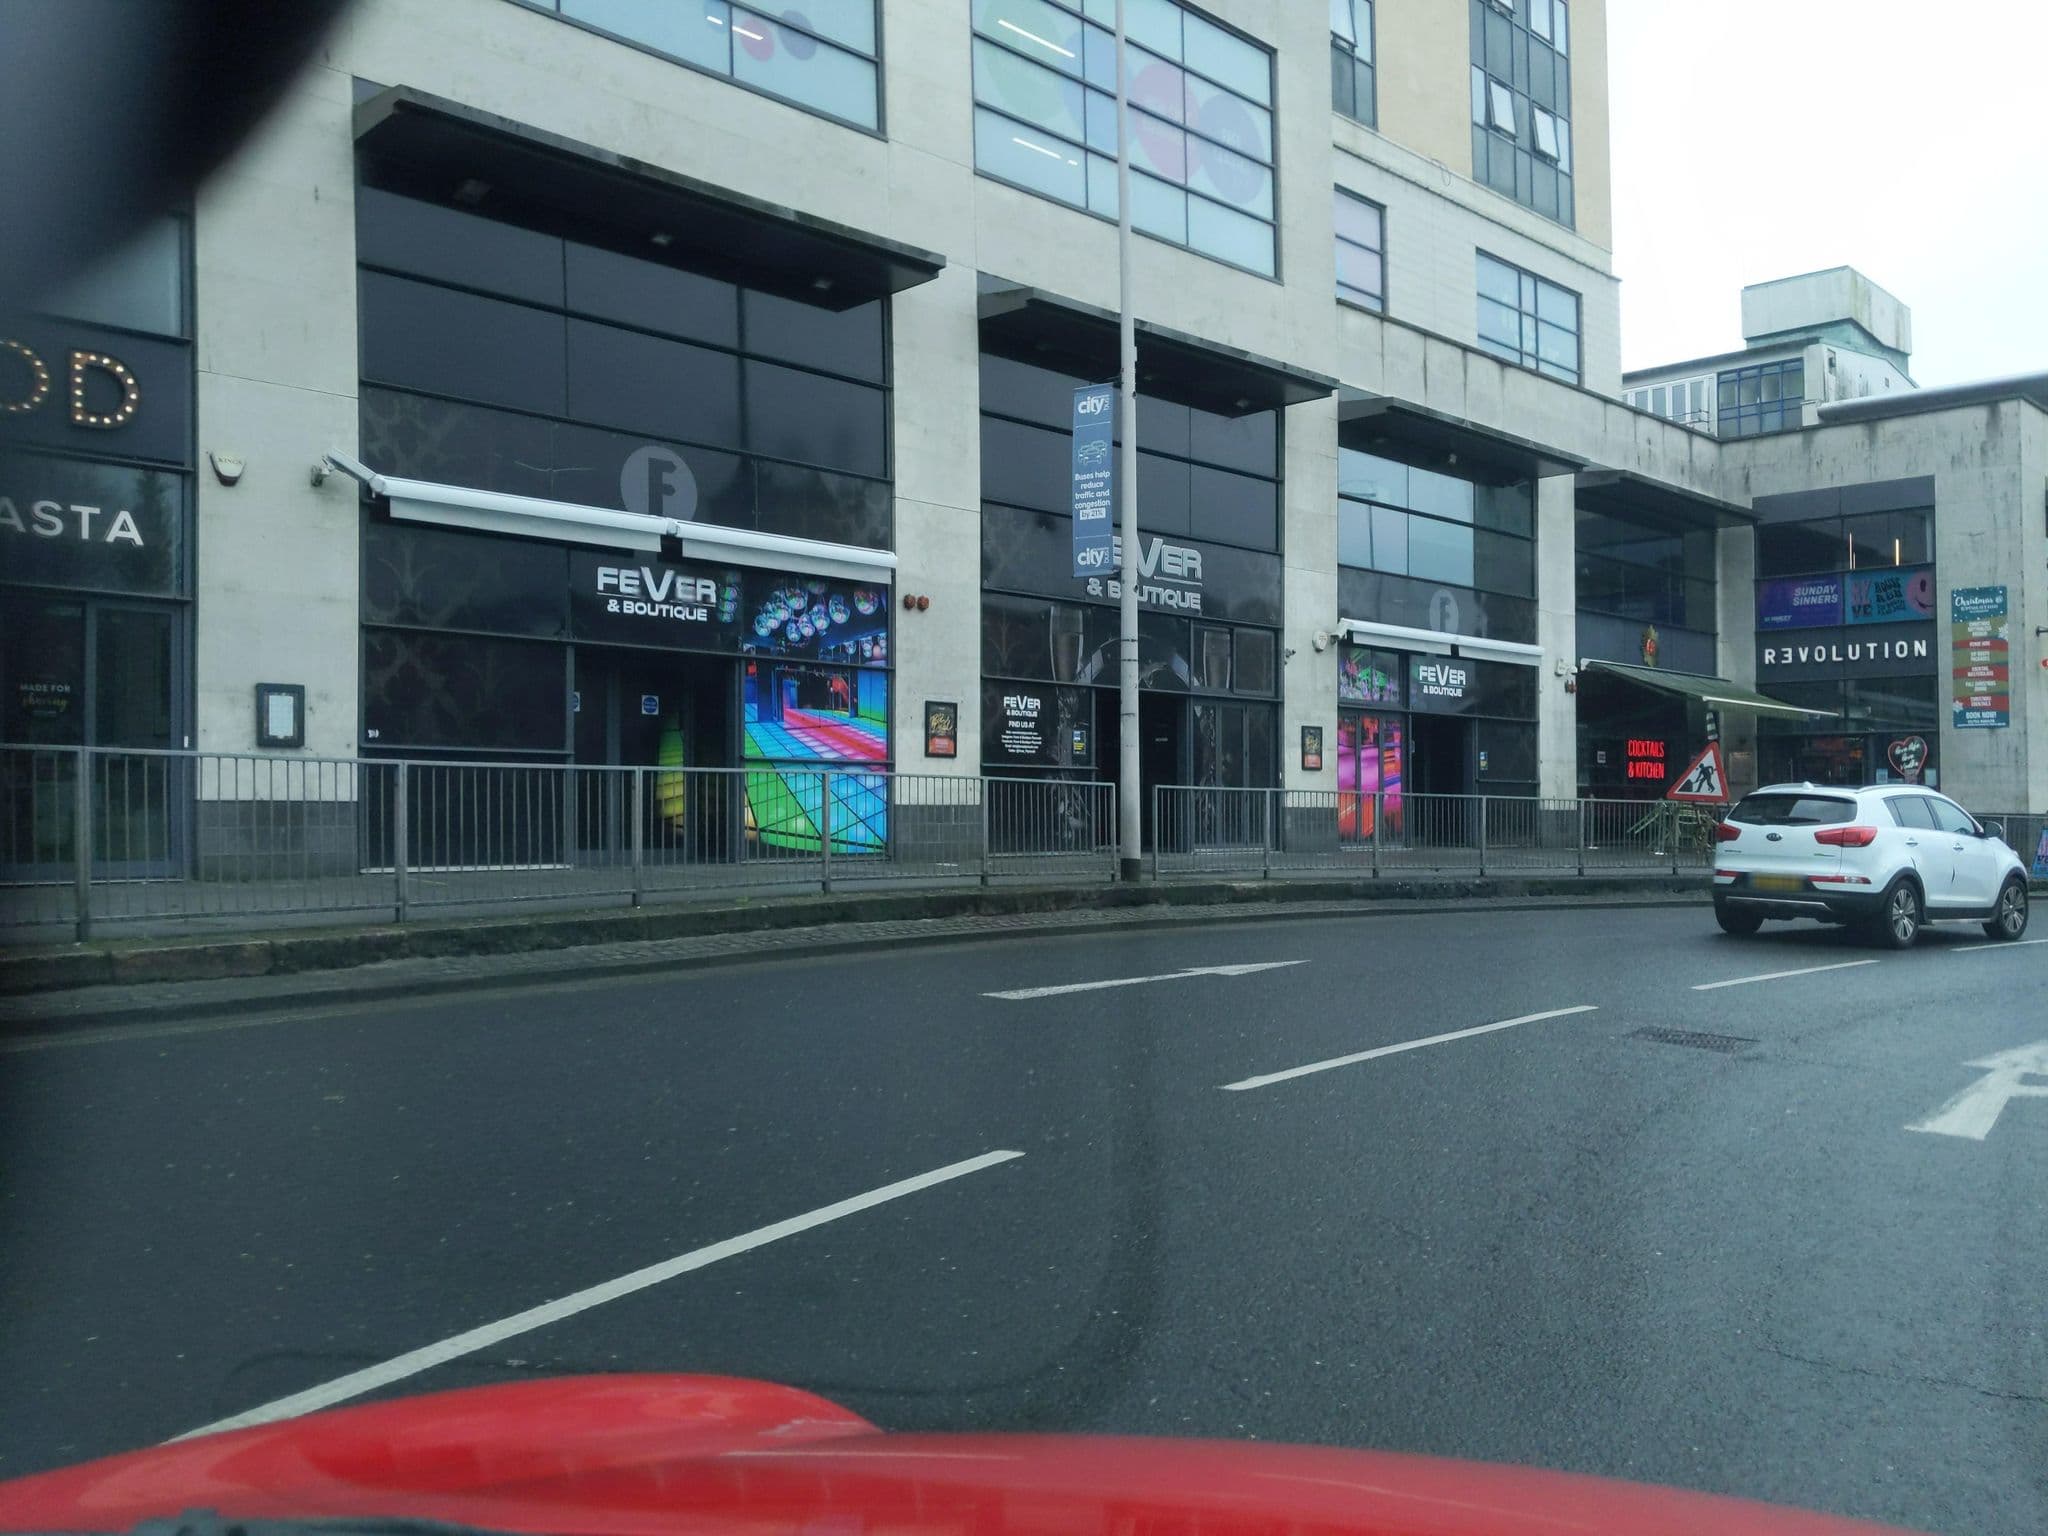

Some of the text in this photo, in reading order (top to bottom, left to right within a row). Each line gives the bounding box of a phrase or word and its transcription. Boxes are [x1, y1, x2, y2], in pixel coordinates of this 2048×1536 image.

[1078, 396, 1103, 415] city
[1074, 470, 1111, 481] Buses help
[1080, 481, 1104, 489] reduce
[1075, 489, 1110, 500] traffic and
[1074, 499, 1111, 510] congestion
[1077, 547, 1104, 568] city
[597, 566, 717, 604] FEVER
[1794, 584, 1837, 596] SUNDAY
[1087, 577, 1201, 610] & BUTIQUE
[1792, 594, 1838, 607] SINNERS
[607, 600, 708, 621] & BOUTIQUE
[1764, 639, 1928, 665] REVOLUTION
[1419, 664, 1466, 686] FEVER
[1429, 686, 1463, 697] BOUTIQUE
[1003, 695, 1041, 710] FEVER
[1011, 709, 1038, 718] BOUTIQUE
[1008, 720, 1021, 728] FIND
[1028, 721, 1036, 729] AT
[1627, 740, 1665, 757] COCKTAILS
[1628, 761, 1665, 779] & KITCHEN
